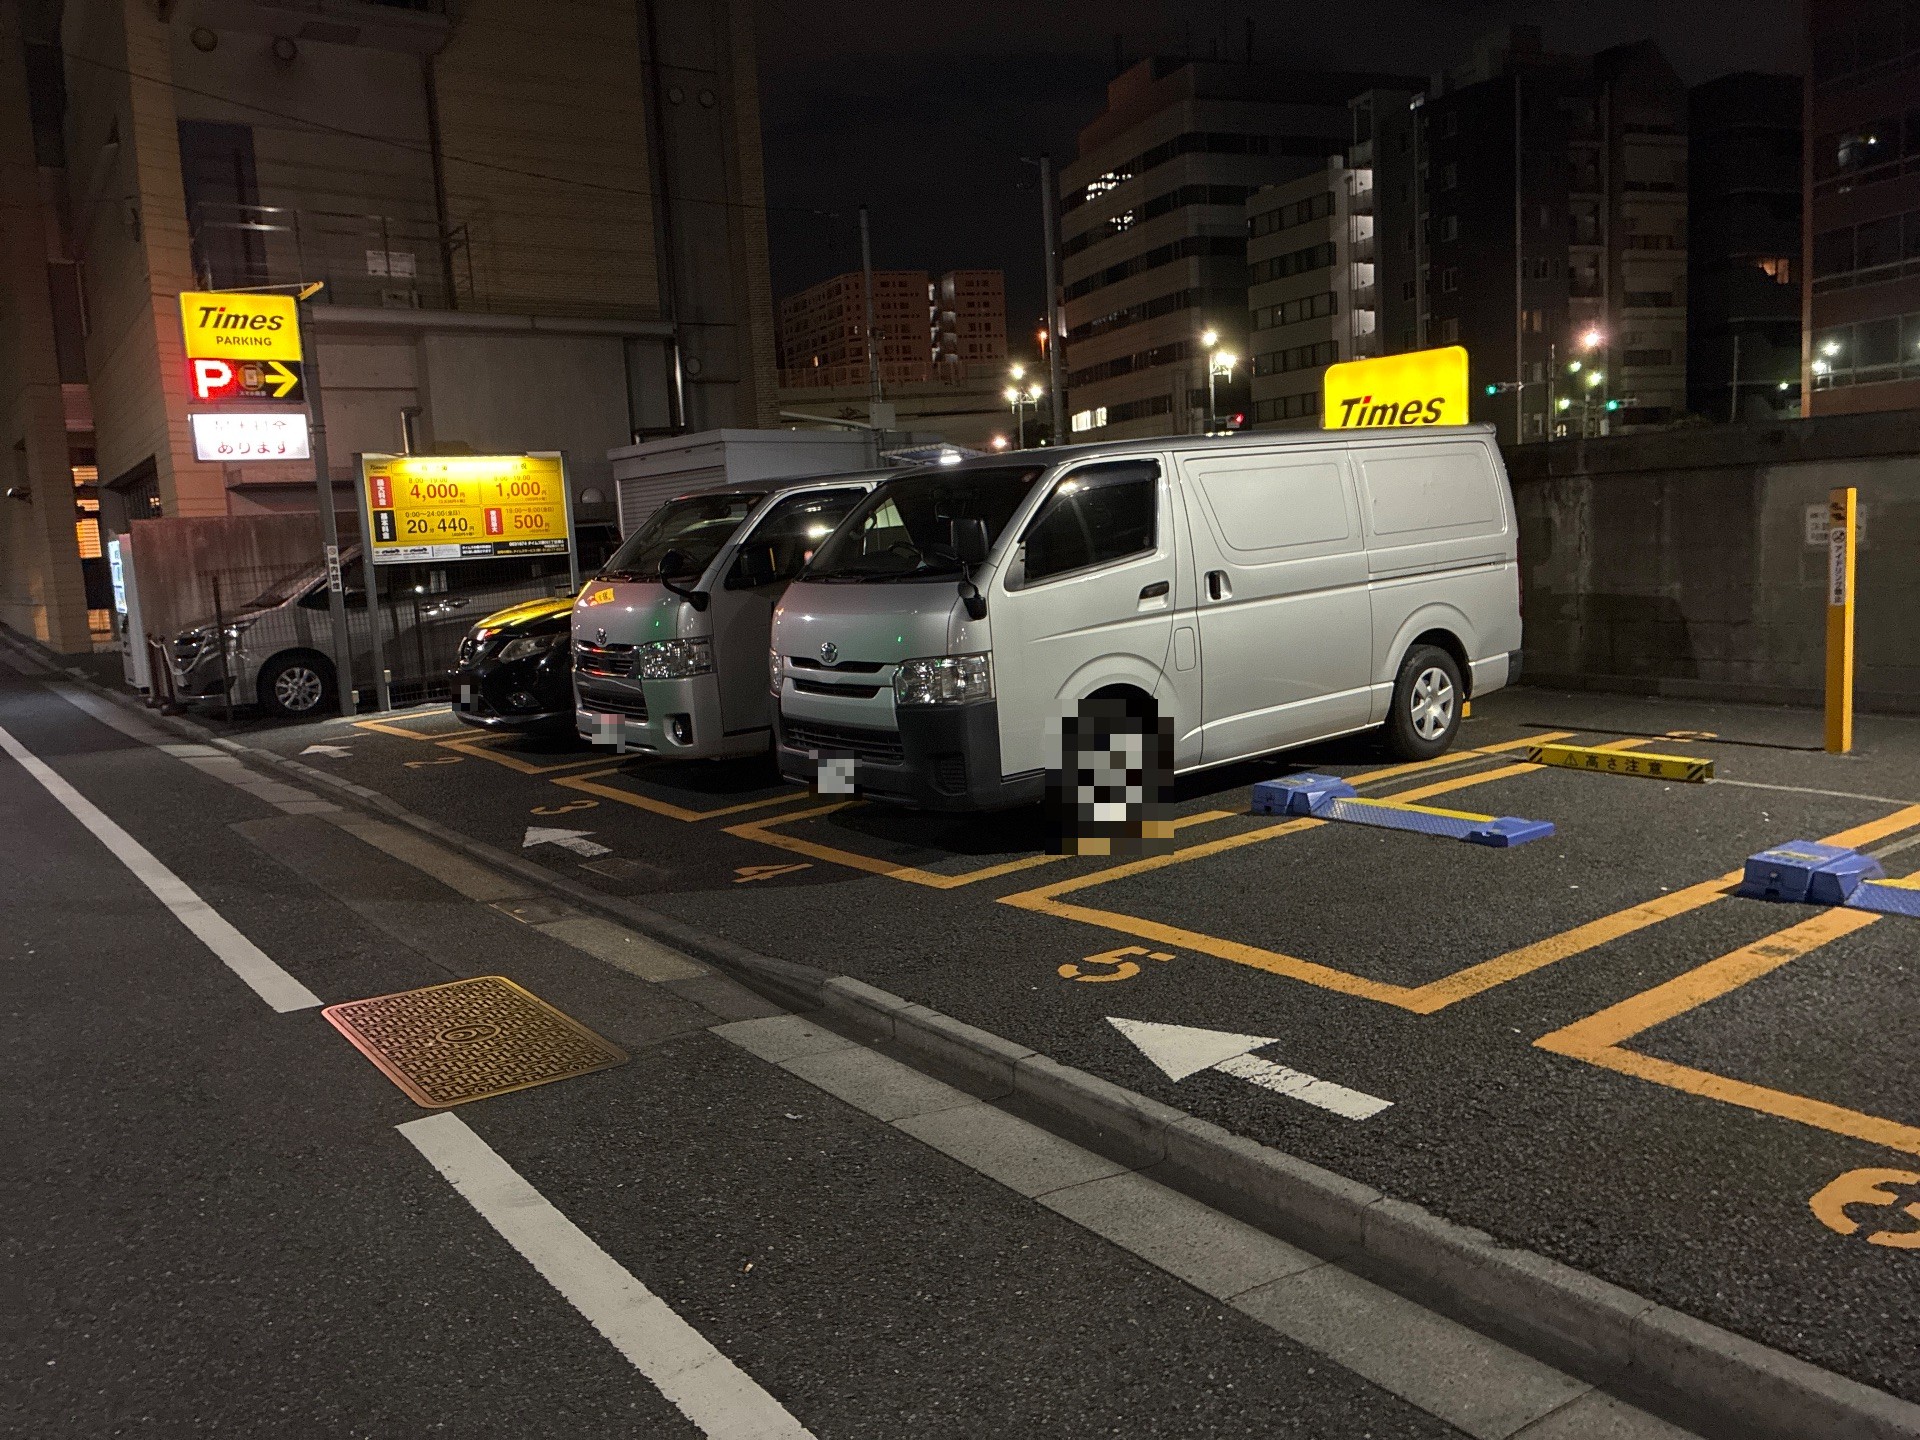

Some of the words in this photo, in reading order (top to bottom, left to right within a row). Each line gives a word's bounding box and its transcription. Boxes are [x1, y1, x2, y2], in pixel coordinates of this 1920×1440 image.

[199, 307, 284, 331] Times
[216, 336, 272, 347] PARKING
[194, 360, 232, 397] P
[1341, 395, 1446, 427] Times
[218, 441, 286, 454] あります
[1585, 754, 1663, 775] 高さ注意
[530, 800, 600, 816] 3
[732, 862, 814, 883] 4
[1057, 946, 1176, 983] 5
